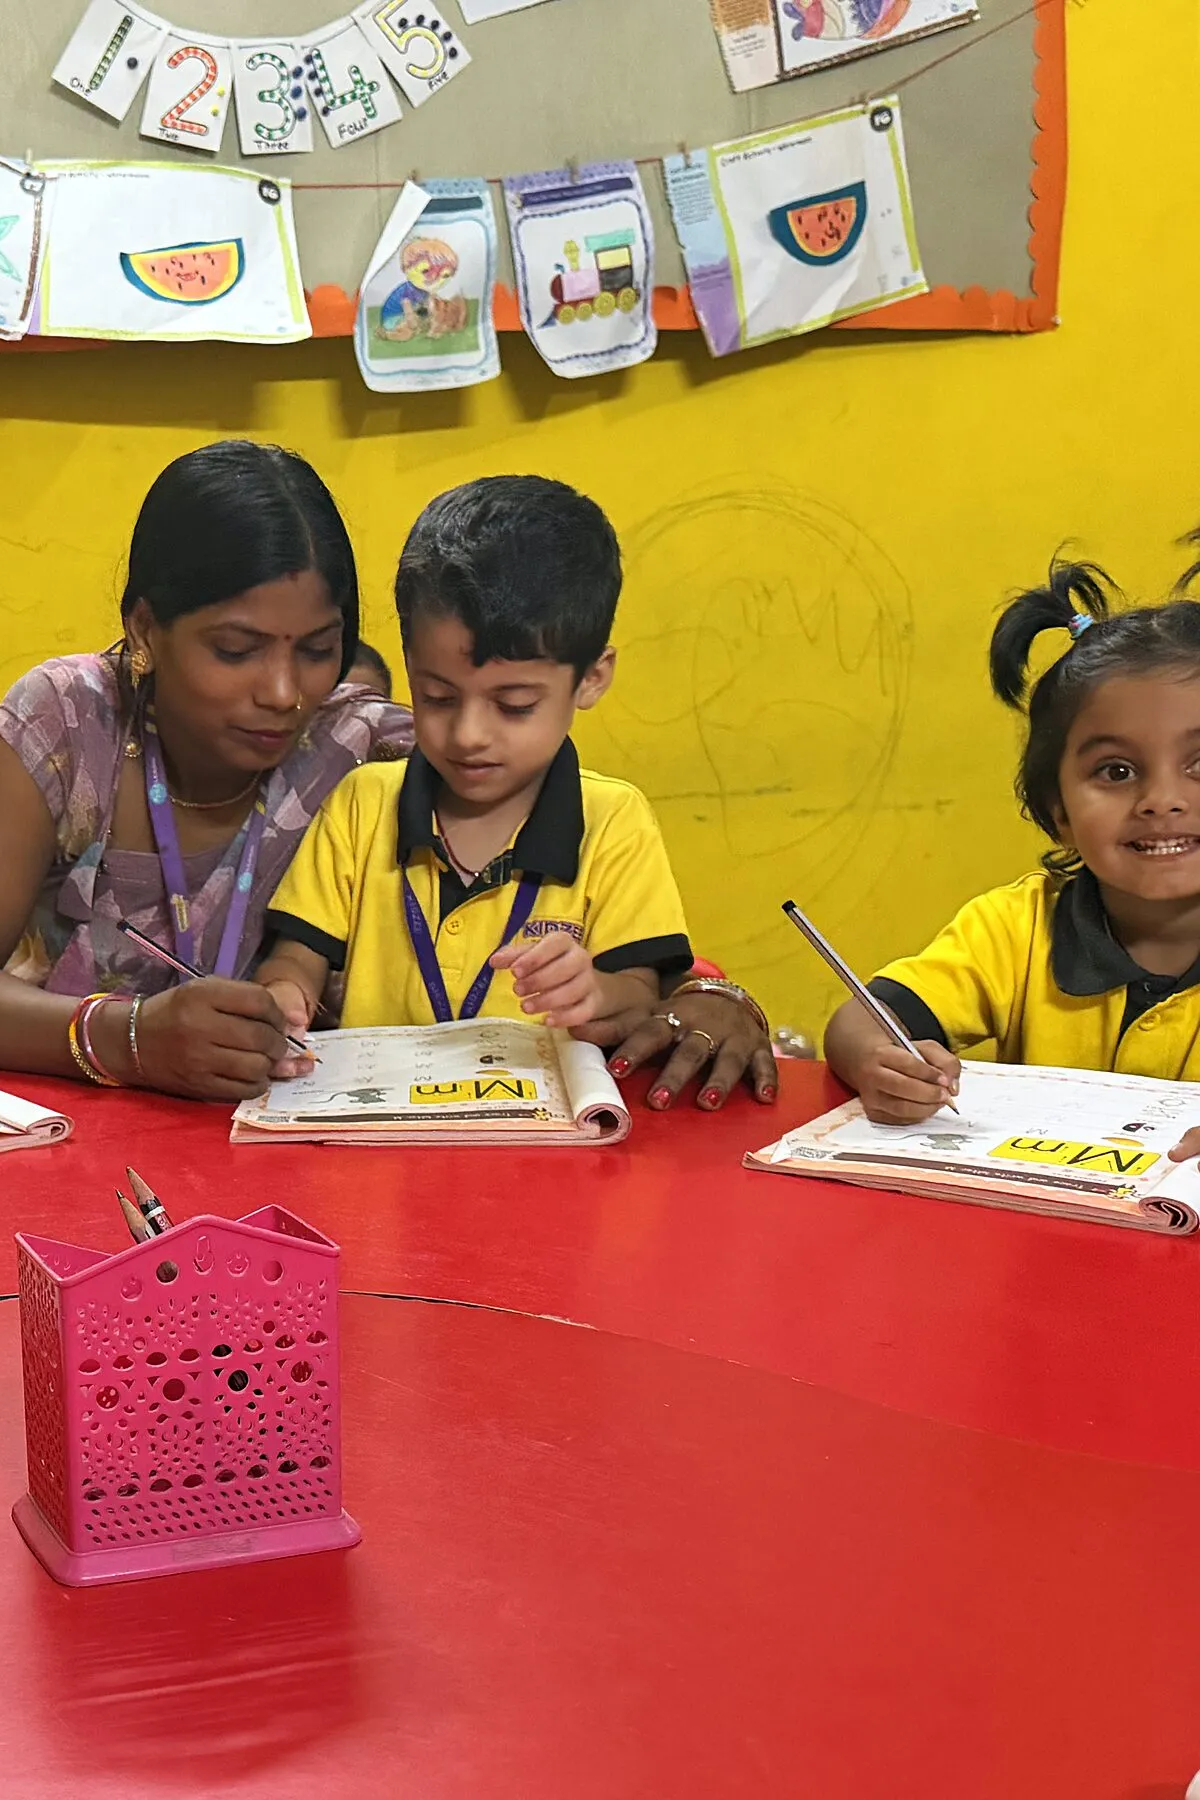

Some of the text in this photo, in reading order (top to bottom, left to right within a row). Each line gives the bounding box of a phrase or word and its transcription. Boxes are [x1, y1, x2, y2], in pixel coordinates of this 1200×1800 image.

[90, 15, 133, 90] 1
[373, 0, 446, 80] 5
[70, 77, 92, 97] One
[160, 46, 218, 136] 2
[246, 52, 296, 140] 3
[311, 49, 380, 118] 4
[253, 140, 289, 150] Three
[337, 117, 368, 140] Four
